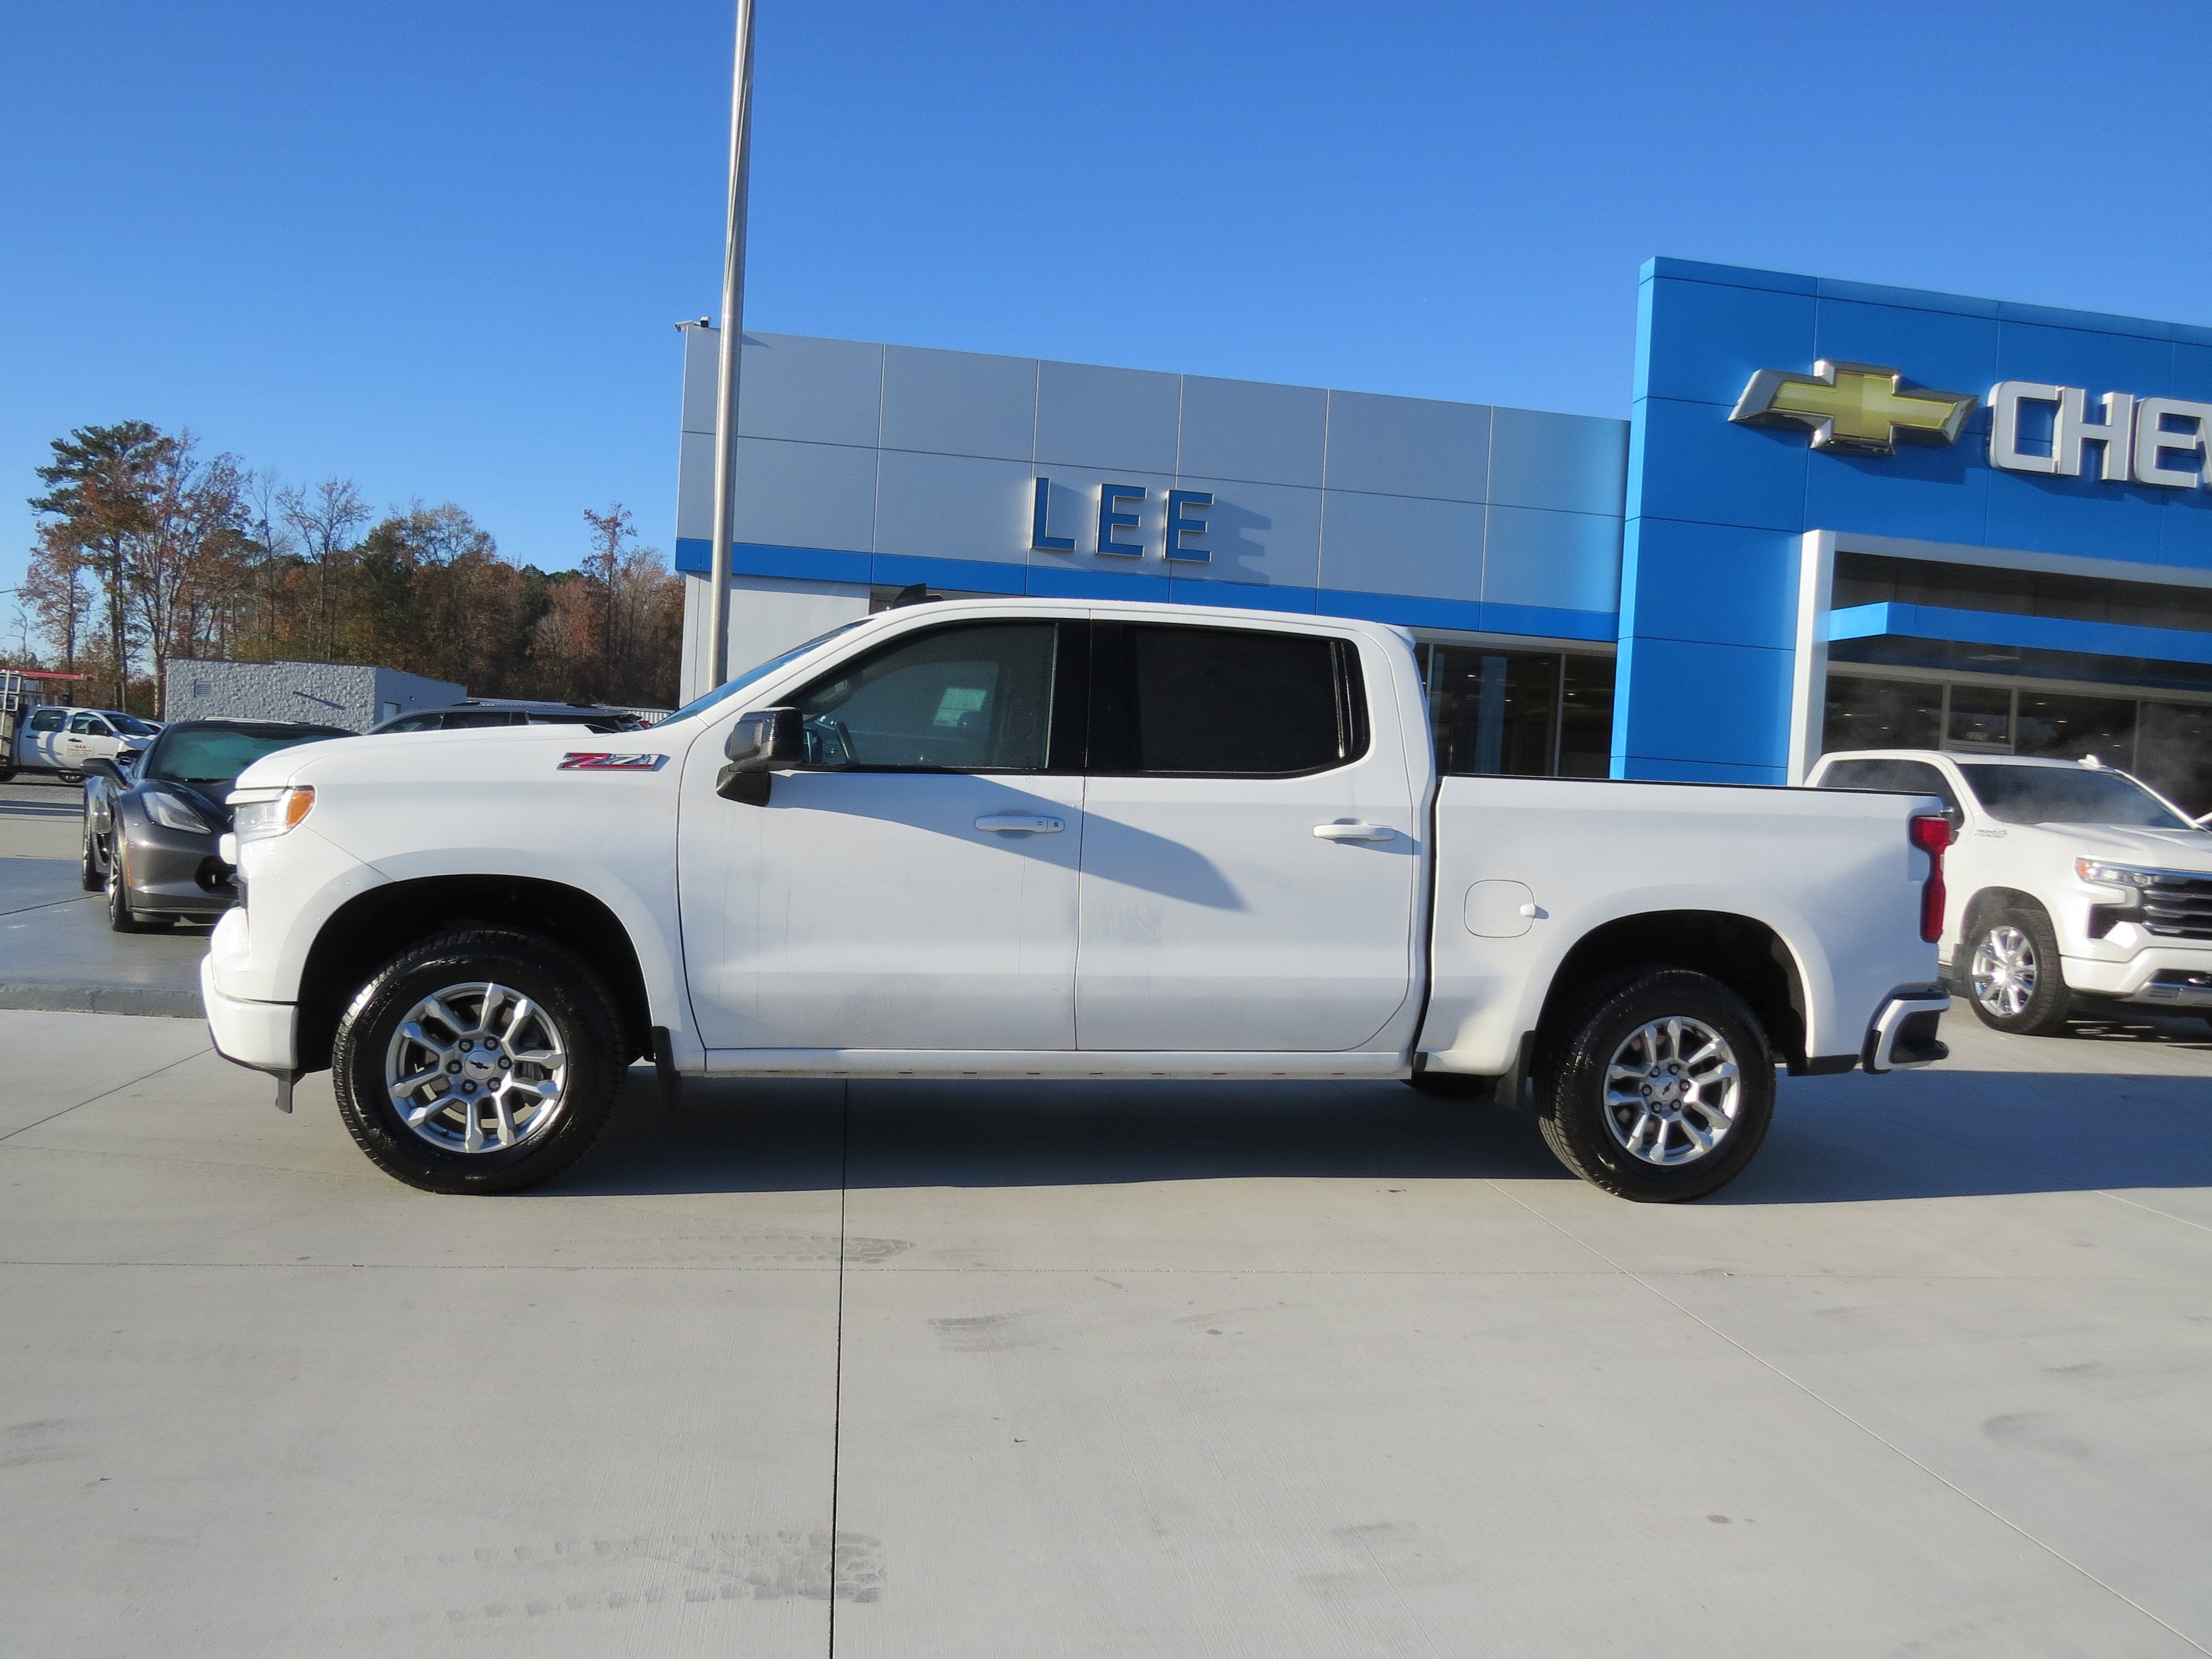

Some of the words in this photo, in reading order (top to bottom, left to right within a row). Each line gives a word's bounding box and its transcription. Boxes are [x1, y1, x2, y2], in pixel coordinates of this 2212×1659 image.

[1987, 380, 2212, 489] CHE
[1030, 477, 1214, 563] LEE
[556, 752, 671, 772] Z71
